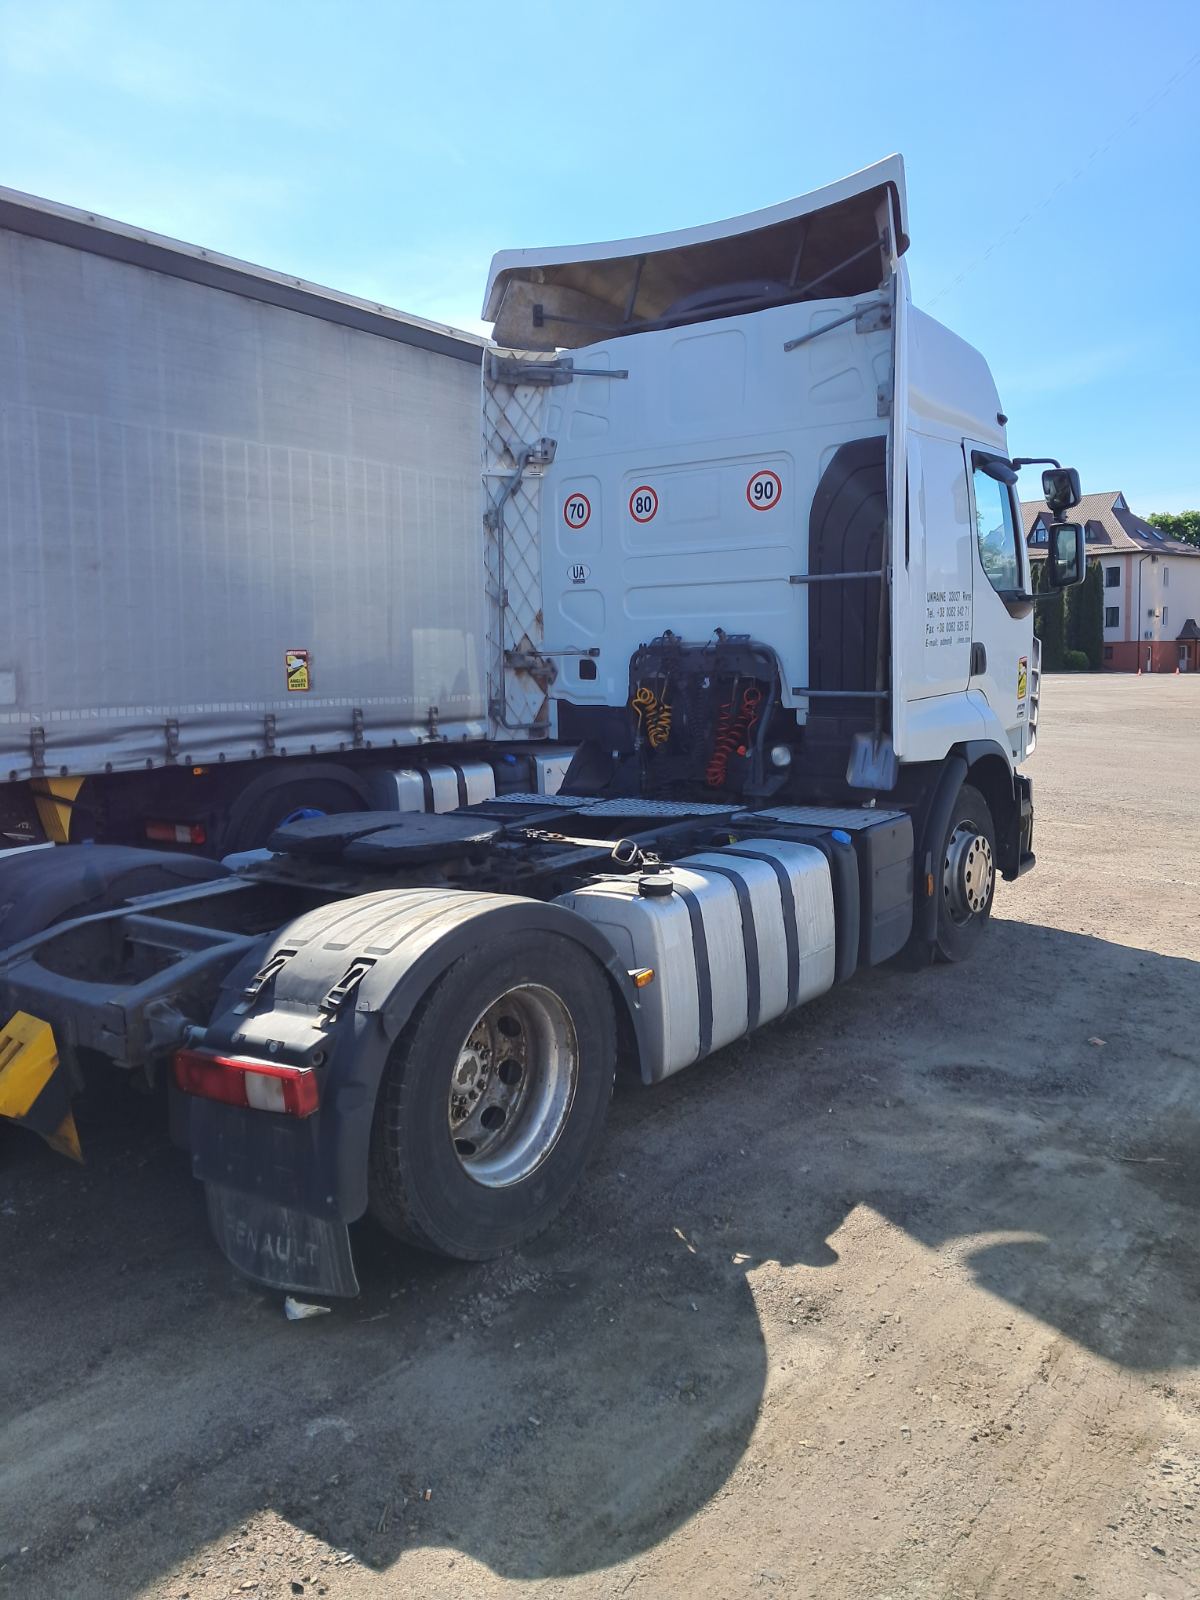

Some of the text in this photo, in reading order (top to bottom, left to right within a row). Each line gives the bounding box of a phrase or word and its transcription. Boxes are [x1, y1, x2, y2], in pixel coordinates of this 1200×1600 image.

[754, 481, 774, 500] 90
[569, 503, 584, 519] 70
[635, 496, 651, 514] 80
[573, 565, 585, 579] UA
[926, 591, 946, 602] UKRAINE
